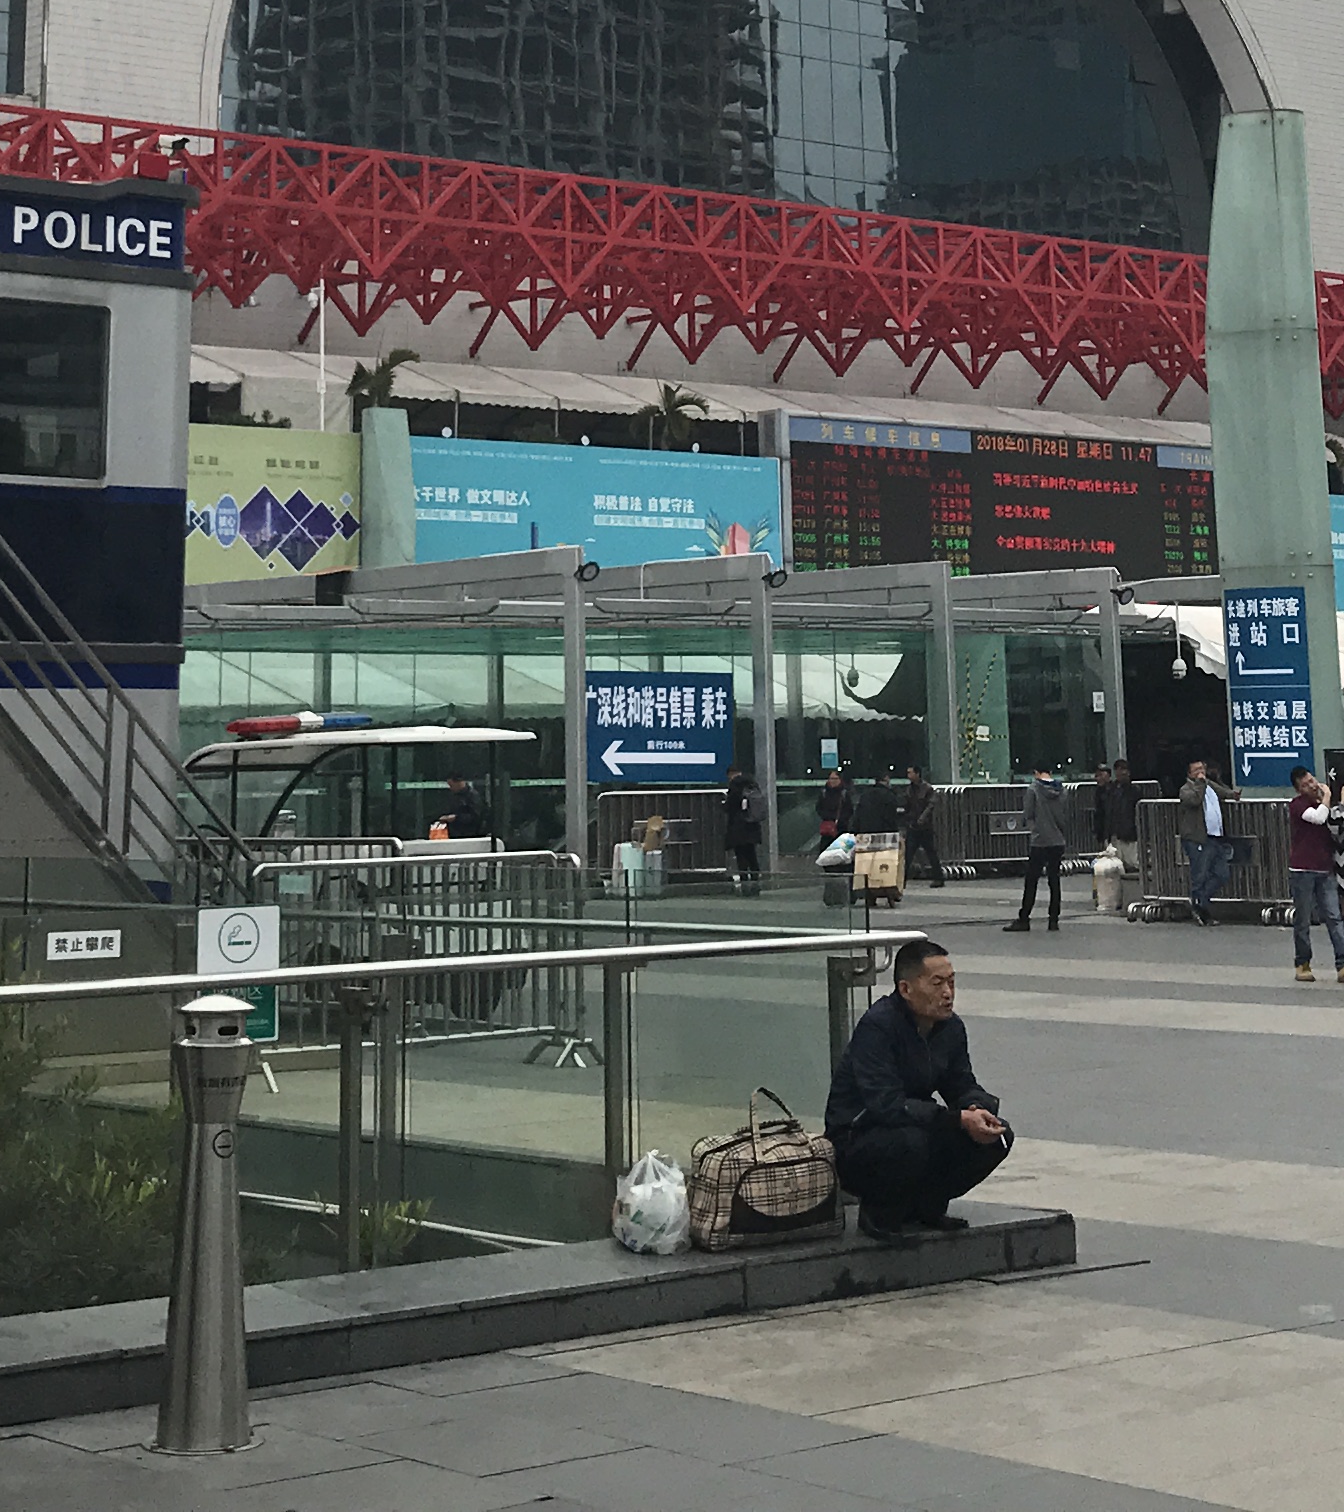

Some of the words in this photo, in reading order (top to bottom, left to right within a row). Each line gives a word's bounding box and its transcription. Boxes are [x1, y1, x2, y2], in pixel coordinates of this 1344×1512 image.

[13, 205, 173, 259] POLICE
[1077, 441, 1113, 460] 星期日
[648, 496, 695, 514] 自觉守法
[1227, 597, 1300, 619] 长途列车旅客
[1228, 621, 1300, 647] 进站口
[586, 685, 696, 729] 广深线和谐号售票
[701, 687, 728, 729] 乘车
[1232, 700, 1308, 721] 地铁交通层
[1234, 725, 1310, 748] 临时集结区
[54, 936, 115, 954] 禁止攀爬
